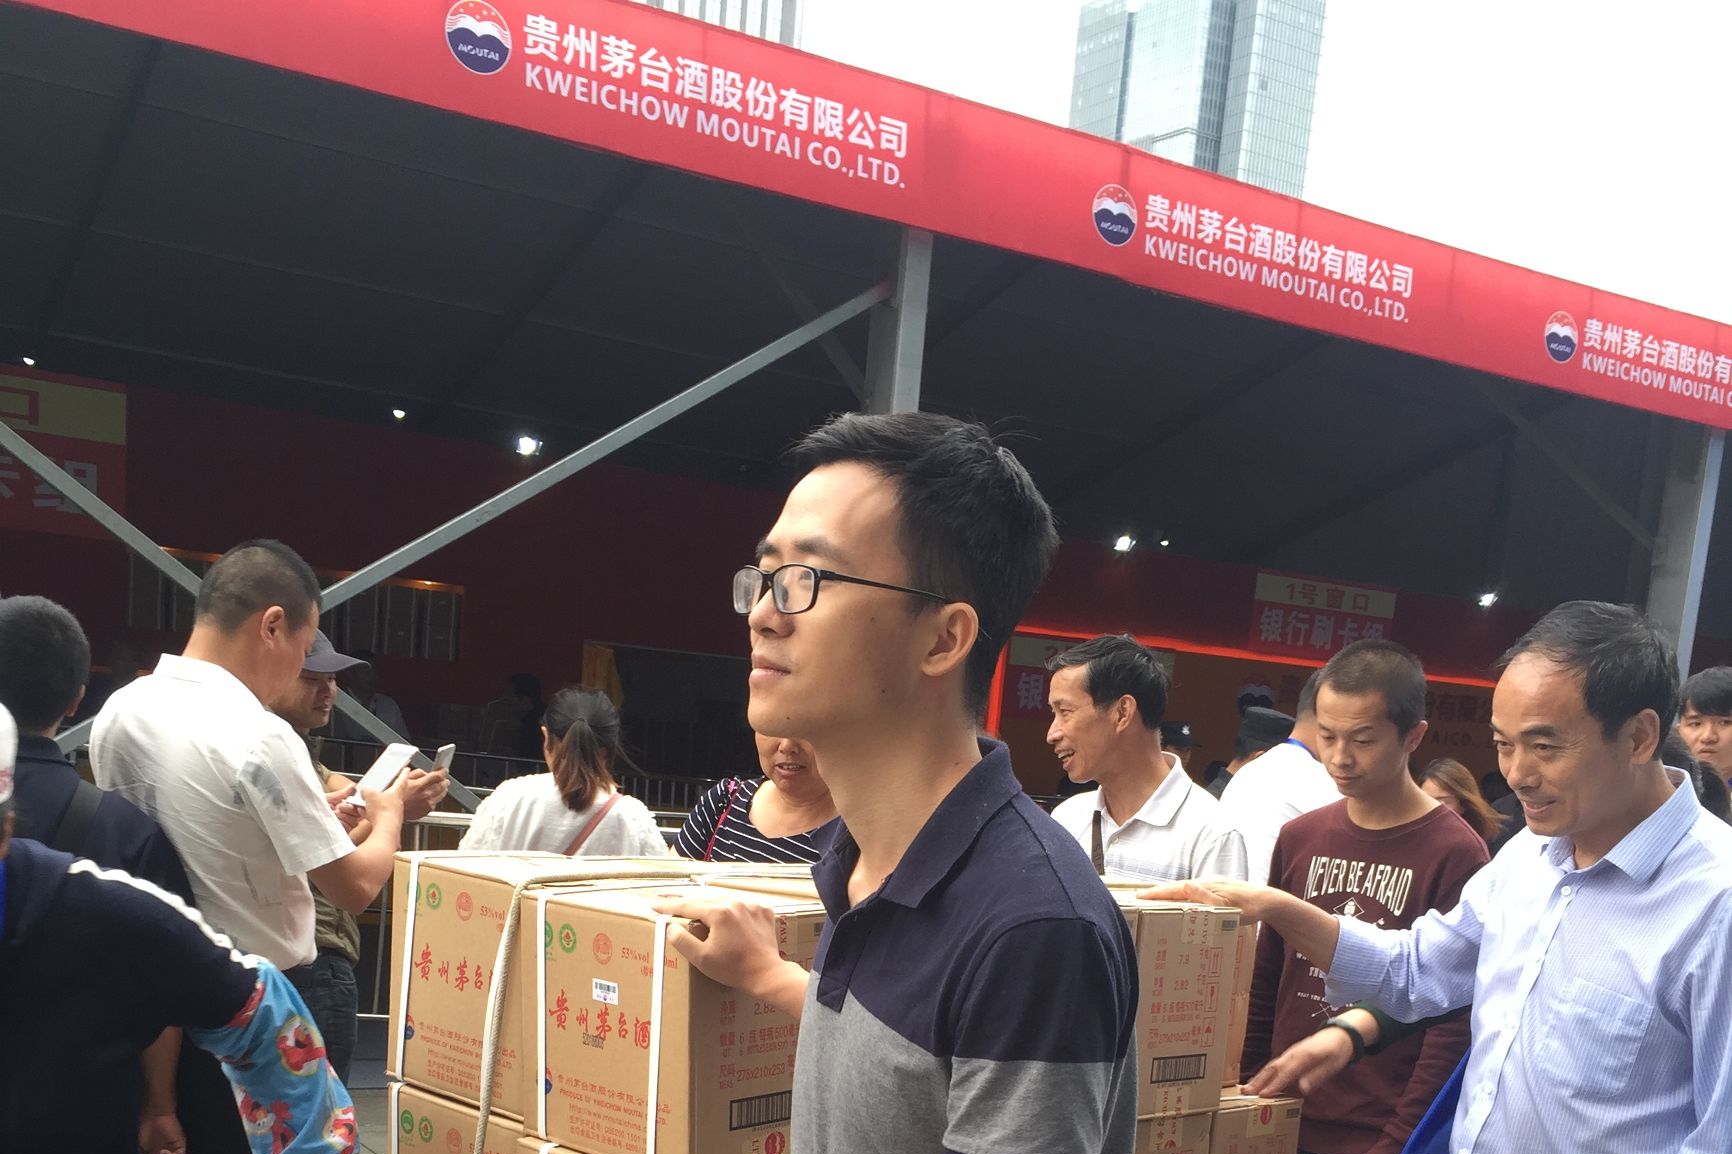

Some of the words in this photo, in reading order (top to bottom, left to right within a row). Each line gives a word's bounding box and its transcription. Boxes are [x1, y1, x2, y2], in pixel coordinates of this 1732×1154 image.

[458, 42, 500, 62] MOUTAI
[523, 14, 909, 159] 贵州茅台酒股份有限公司
[525, 62, 689, 130] KWEICHOW
[696, 110, 801, 160] MOUTAI
[807, 141, 906, 189] CO.,LTD.
[1145, 194, 1414, 299] 贵州茅台酒股份有限公司
[1145, 234, 1258, 282] KWEICHOW
[1262, 267, 1336, 304] MOUTAI
[1339, 288, 1409, 324] CO.,LTD.
[1582, 352, 1667, 390] KWEICHOW
[1669, 376, 1725, 405] MOUTAI
[1304, 855, 1347, 900] NEVER
[1346, 860, 1366, 893] BE
[1360, 863, 1413, 917] AFRAID
[414, 942, 494, 994] 贵州茅台
